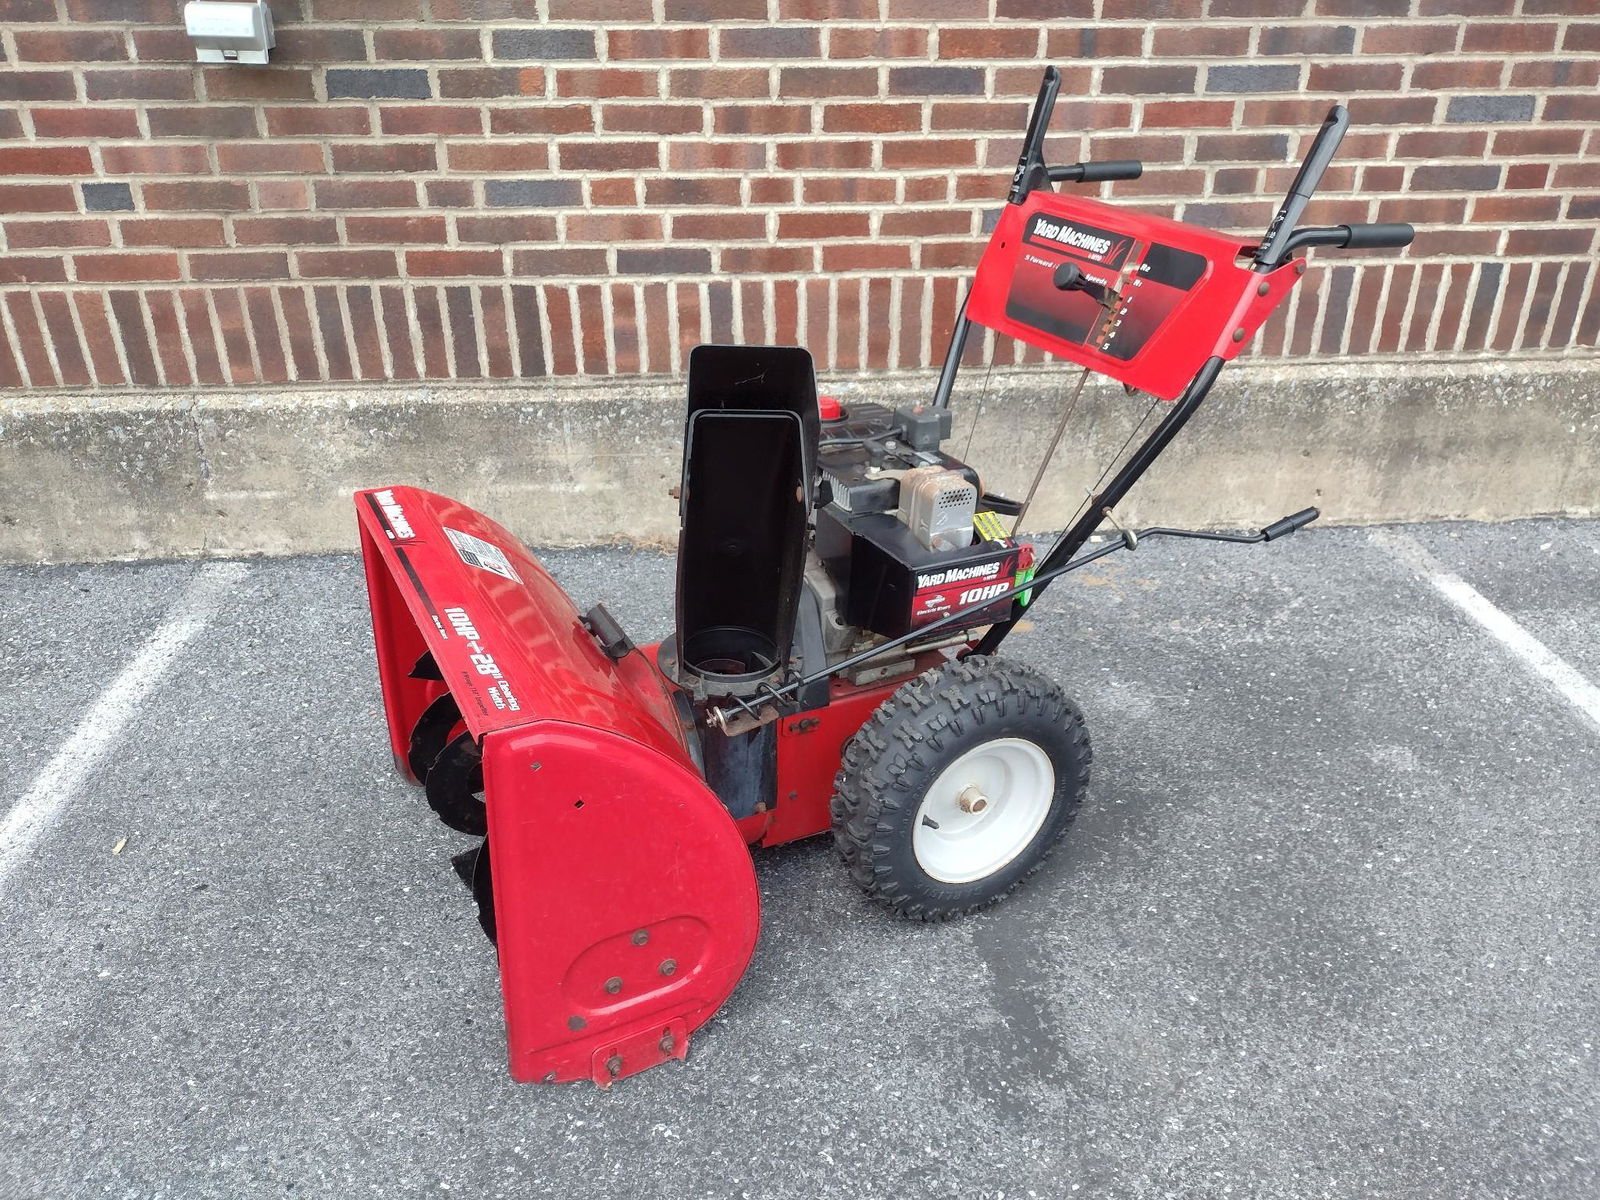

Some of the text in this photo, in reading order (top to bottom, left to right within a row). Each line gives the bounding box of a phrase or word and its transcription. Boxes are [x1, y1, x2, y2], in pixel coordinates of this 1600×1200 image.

[1033, 218, 1111, 254] YARD MACHINES
[1030, 256, 1053, 268] Forward
[1085, 274, 1108, 286] Speeds
[918, 562, 1000, 588] YARD MACHINES
[959, 582, 1010, 605] 10HP
[444, 607, 481, 640] 10HP
[488, 687, 506, 710] Width
[498, 680, 521, 711] Clearing
